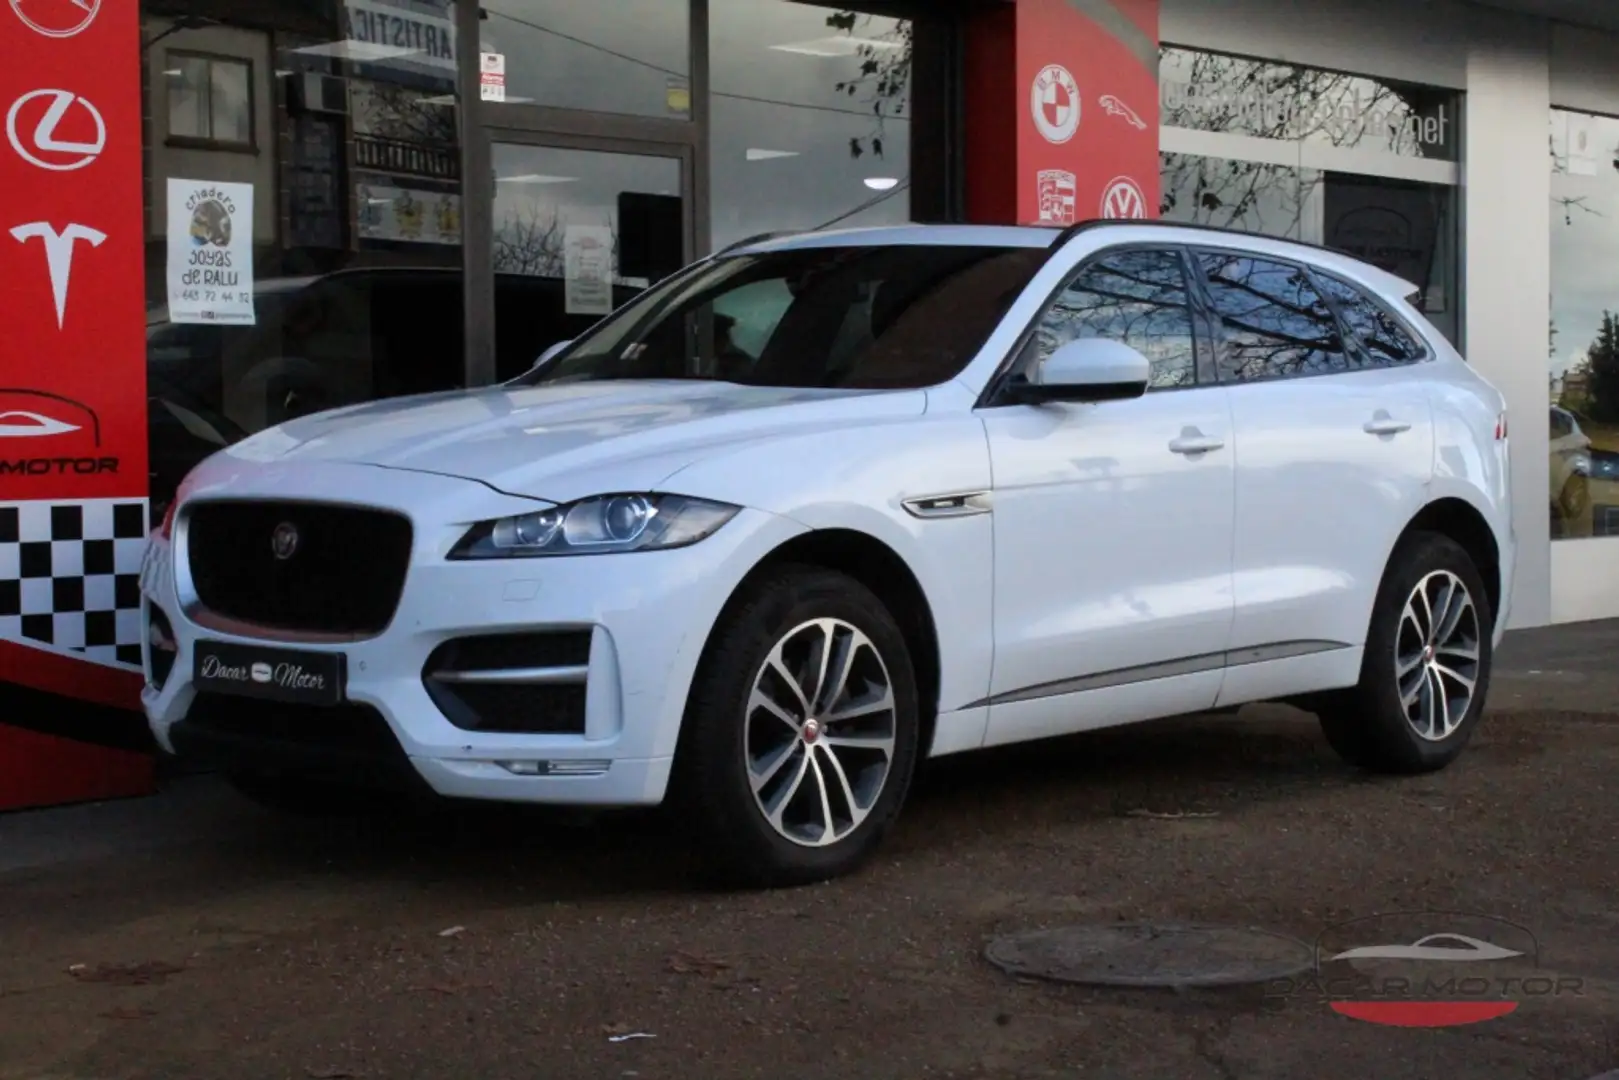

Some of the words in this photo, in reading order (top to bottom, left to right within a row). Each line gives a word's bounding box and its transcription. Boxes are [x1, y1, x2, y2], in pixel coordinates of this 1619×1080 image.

[185, 187, 236, 215] criadero
[204, 270, 238, 286] RALU
[0, 457, 118, 474] MOTOR
[202, 655, 248, 682] Dacar
[275, 662, 325, 690] Motor
